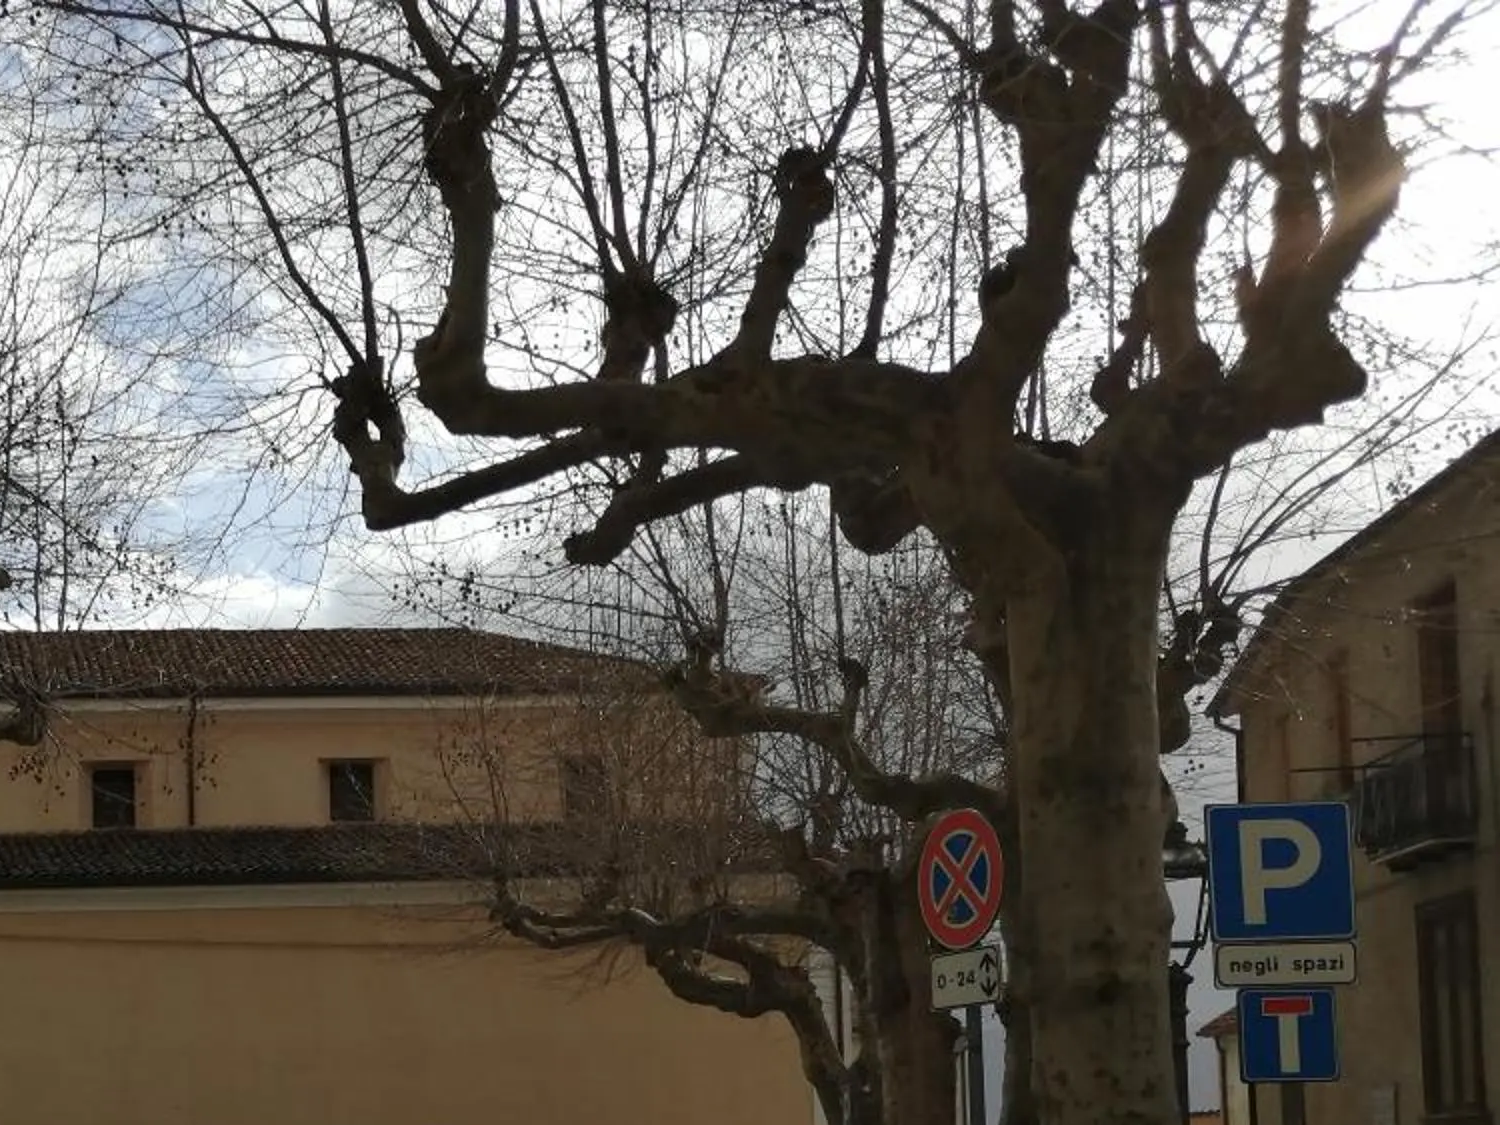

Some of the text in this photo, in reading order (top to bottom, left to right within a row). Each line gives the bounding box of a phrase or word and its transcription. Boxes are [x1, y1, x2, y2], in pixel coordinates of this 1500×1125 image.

[1239, 818, 1322, 925] P
[1229, 952, 1345, 977] negli spazi
[937, 969, 976, 990] 0-24
